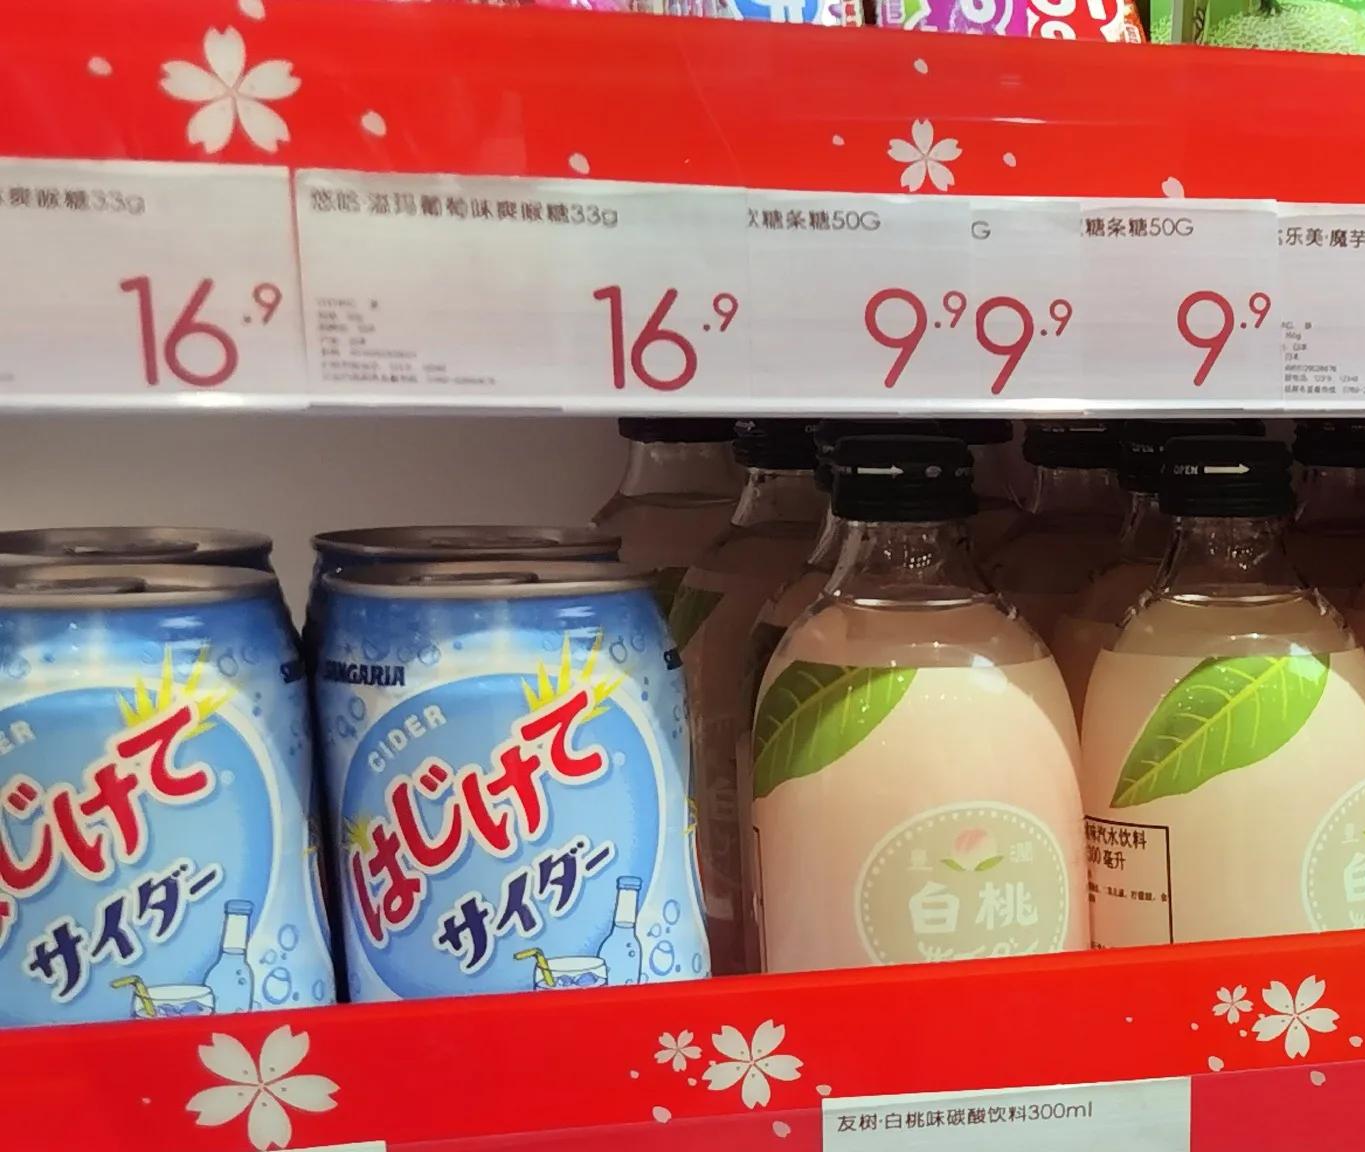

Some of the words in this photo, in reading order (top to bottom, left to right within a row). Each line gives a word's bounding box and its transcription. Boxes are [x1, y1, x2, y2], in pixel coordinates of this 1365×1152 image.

[120, 275, 283, 387] 16.9
[592, 285, 740, 392] 16.9
[865, 287, 967, 389] 9.9
[975, 296, 1073, 396] 9.9
[1176, 290, 1272, 388] 9.9
[367, 705, 447, 773] CIDER
[352, 690, 604, 944] はじけて
[29, 865, 222, 998] サイダー
[438, 838, 613, 969] サイダー
[907, 879, 1039, 934] 白桃
